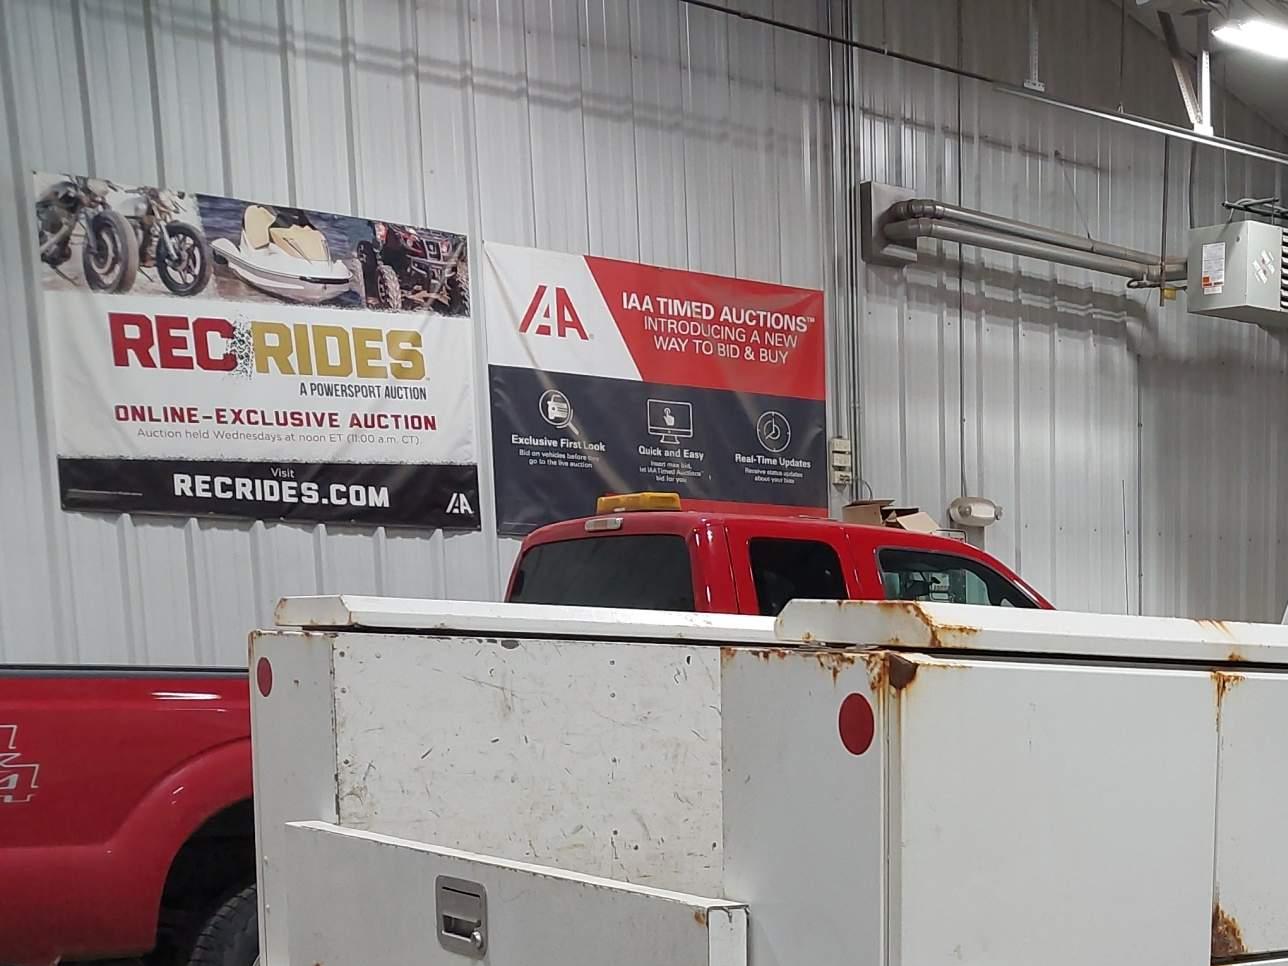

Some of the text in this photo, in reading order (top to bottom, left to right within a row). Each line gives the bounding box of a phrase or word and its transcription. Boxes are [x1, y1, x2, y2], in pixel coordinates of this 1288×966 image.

[622, 291, 654, 313] IAA
[656, 297, 715, 320] TIMED
[644, 316, 798, 348] INTRODUCING A NEW
[108, 312, 426, 380] REC RIDES
[653, 335, 789, 364] WAY TO BID & BUY
[299, 382, 427, 400] A POWERSPORT AUCTION
[114, 405, 437, 431] ONLINE-EXCLUSIVE AUCTION
[137, 428, 182, 439] Auction
[185, 429, 210, 439] held
[213, 430, 282, 443] Wednesdays
[284, 434, 295, 442] at
[299, 434, 326, 442] noon
[329, 433, 344, 443] ET
[511, 434, 606, 452] Exclusive First Look
[638, 445, 704, 461] Quick and Easy
[735, 453, 811, 469] Real-Time Updates
[270, 467, 295, 478] Visit
[173, 473, 390, 508] RECRIDES.COM
